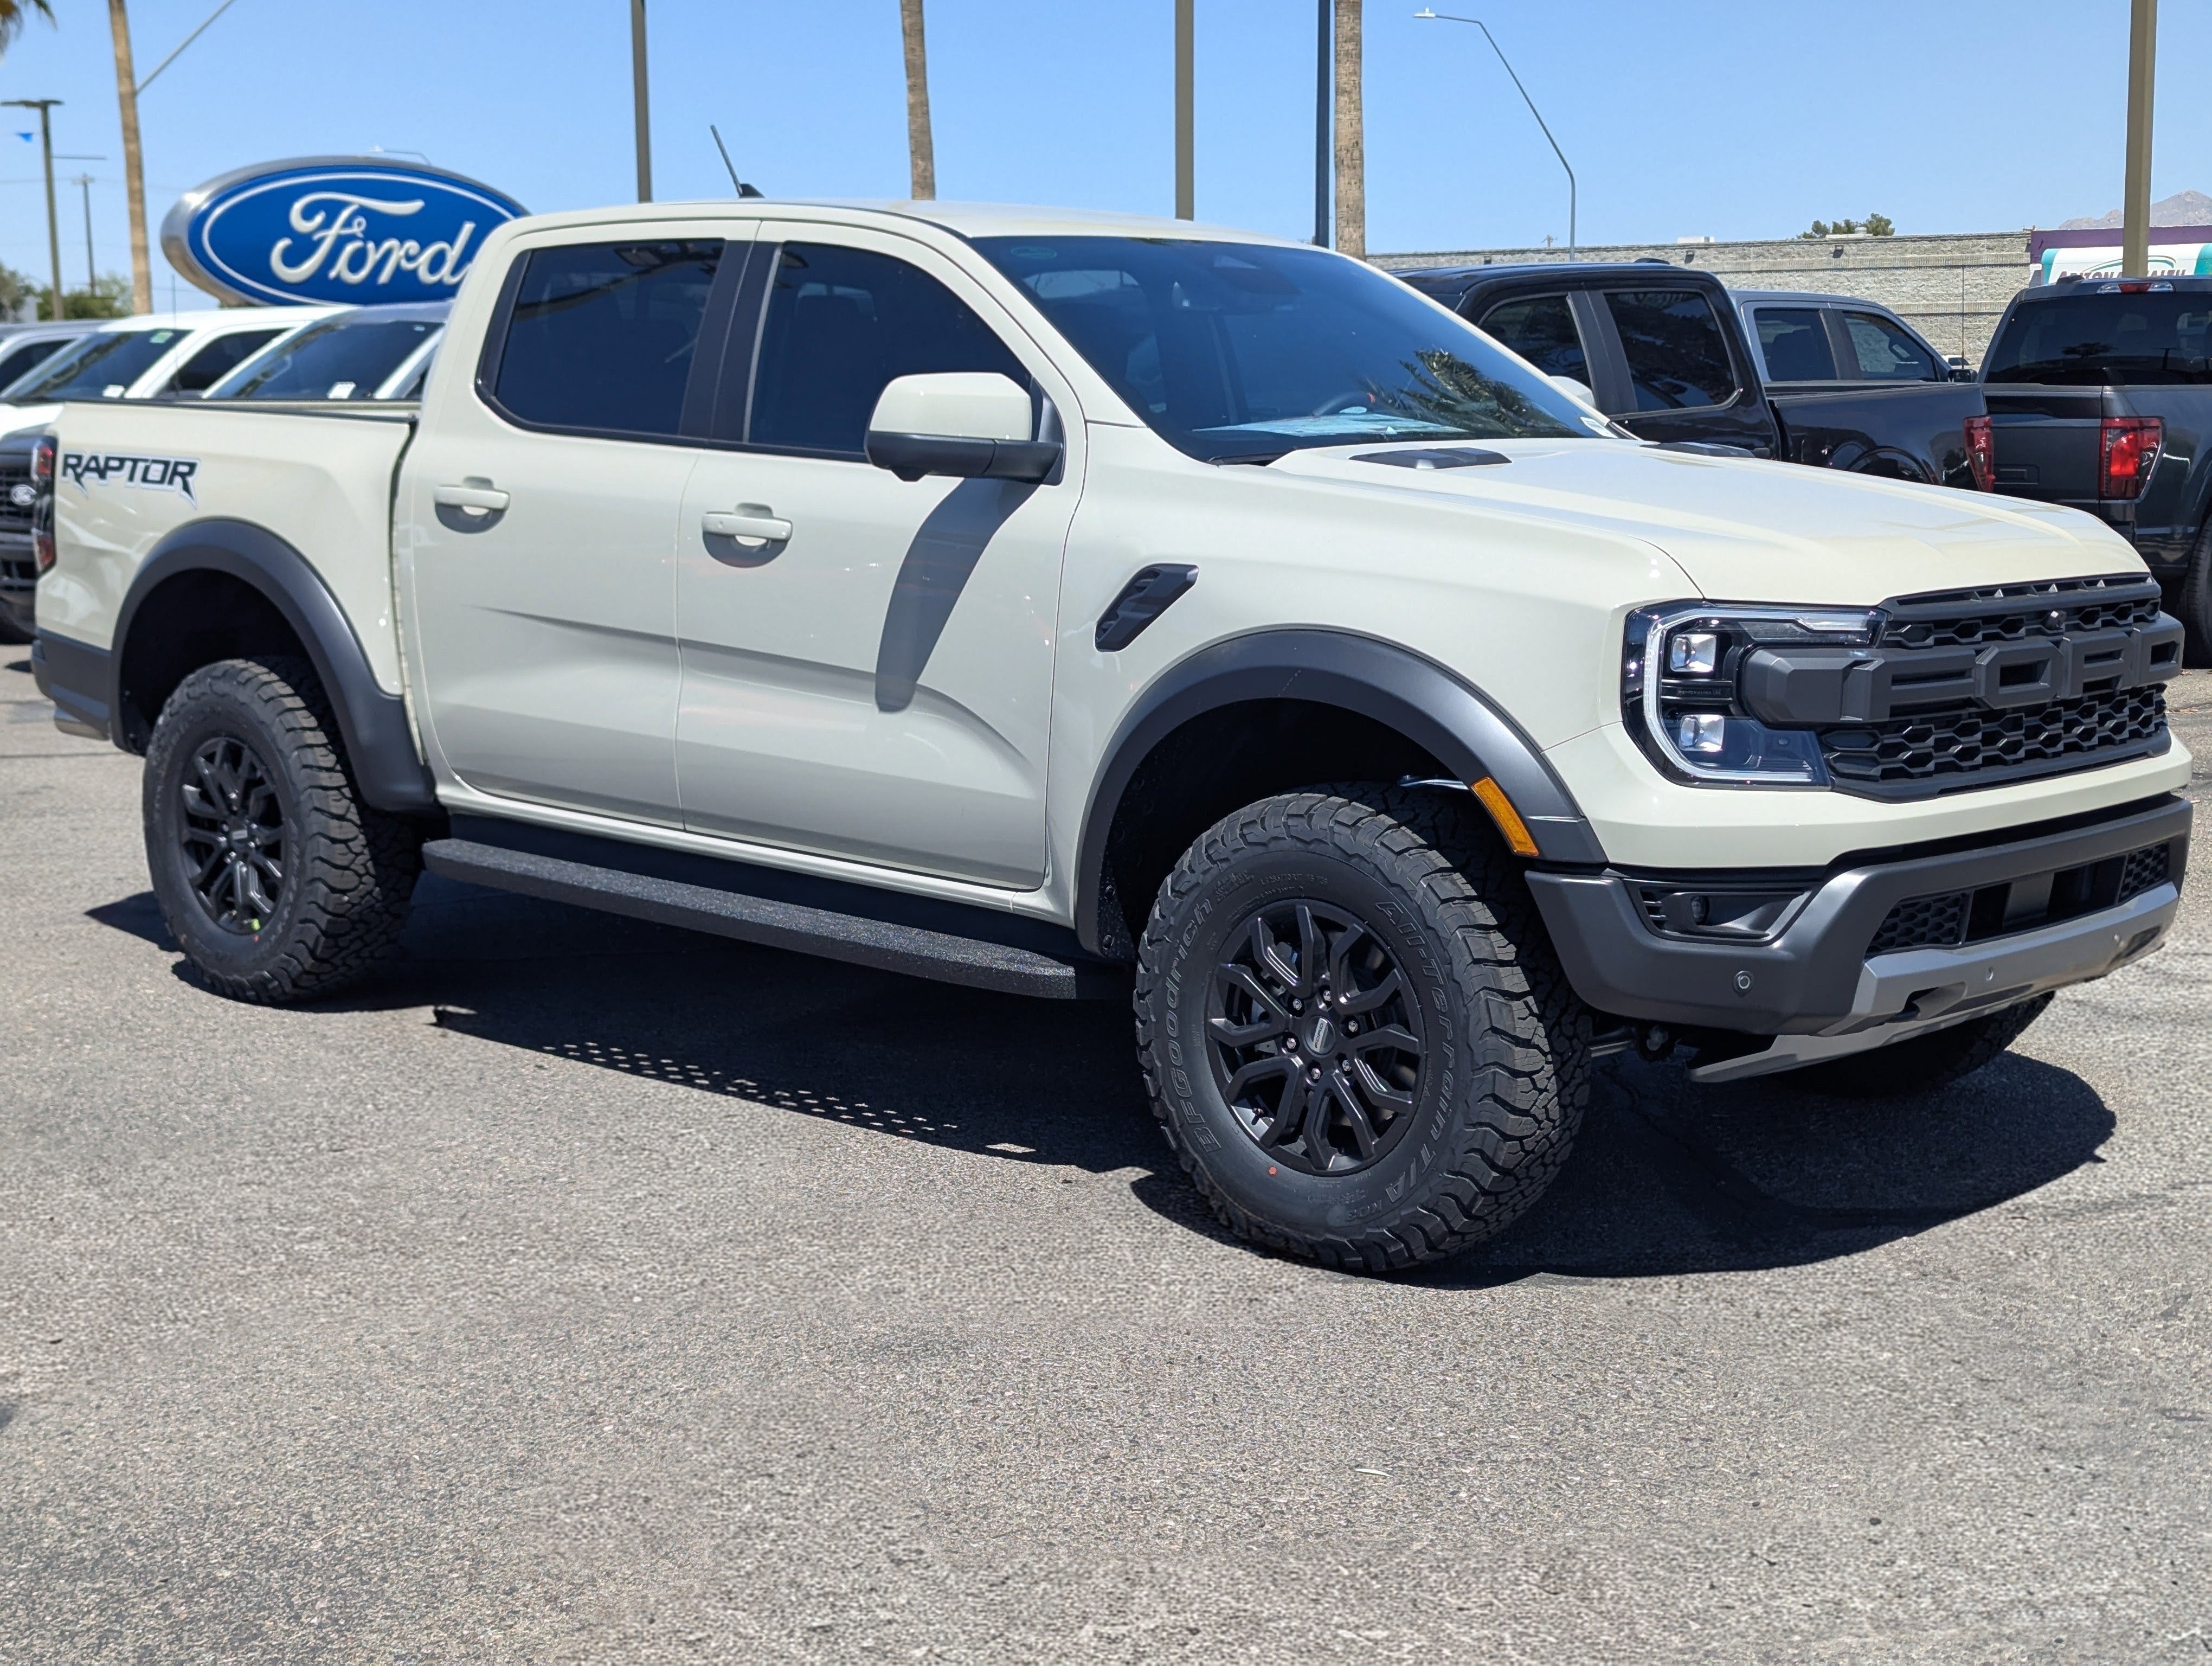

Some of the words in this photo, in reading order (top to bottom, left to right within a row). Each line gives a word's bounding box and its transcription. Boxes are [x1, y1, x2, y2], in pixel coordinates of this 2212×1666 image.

[271, 191, 475, 285] Ford
[63, 452, 200, 508] RAPTOR
[1840, 614, 2185, 722] FORD
[1166, 898, 1222, 1152] BFGoodrich
